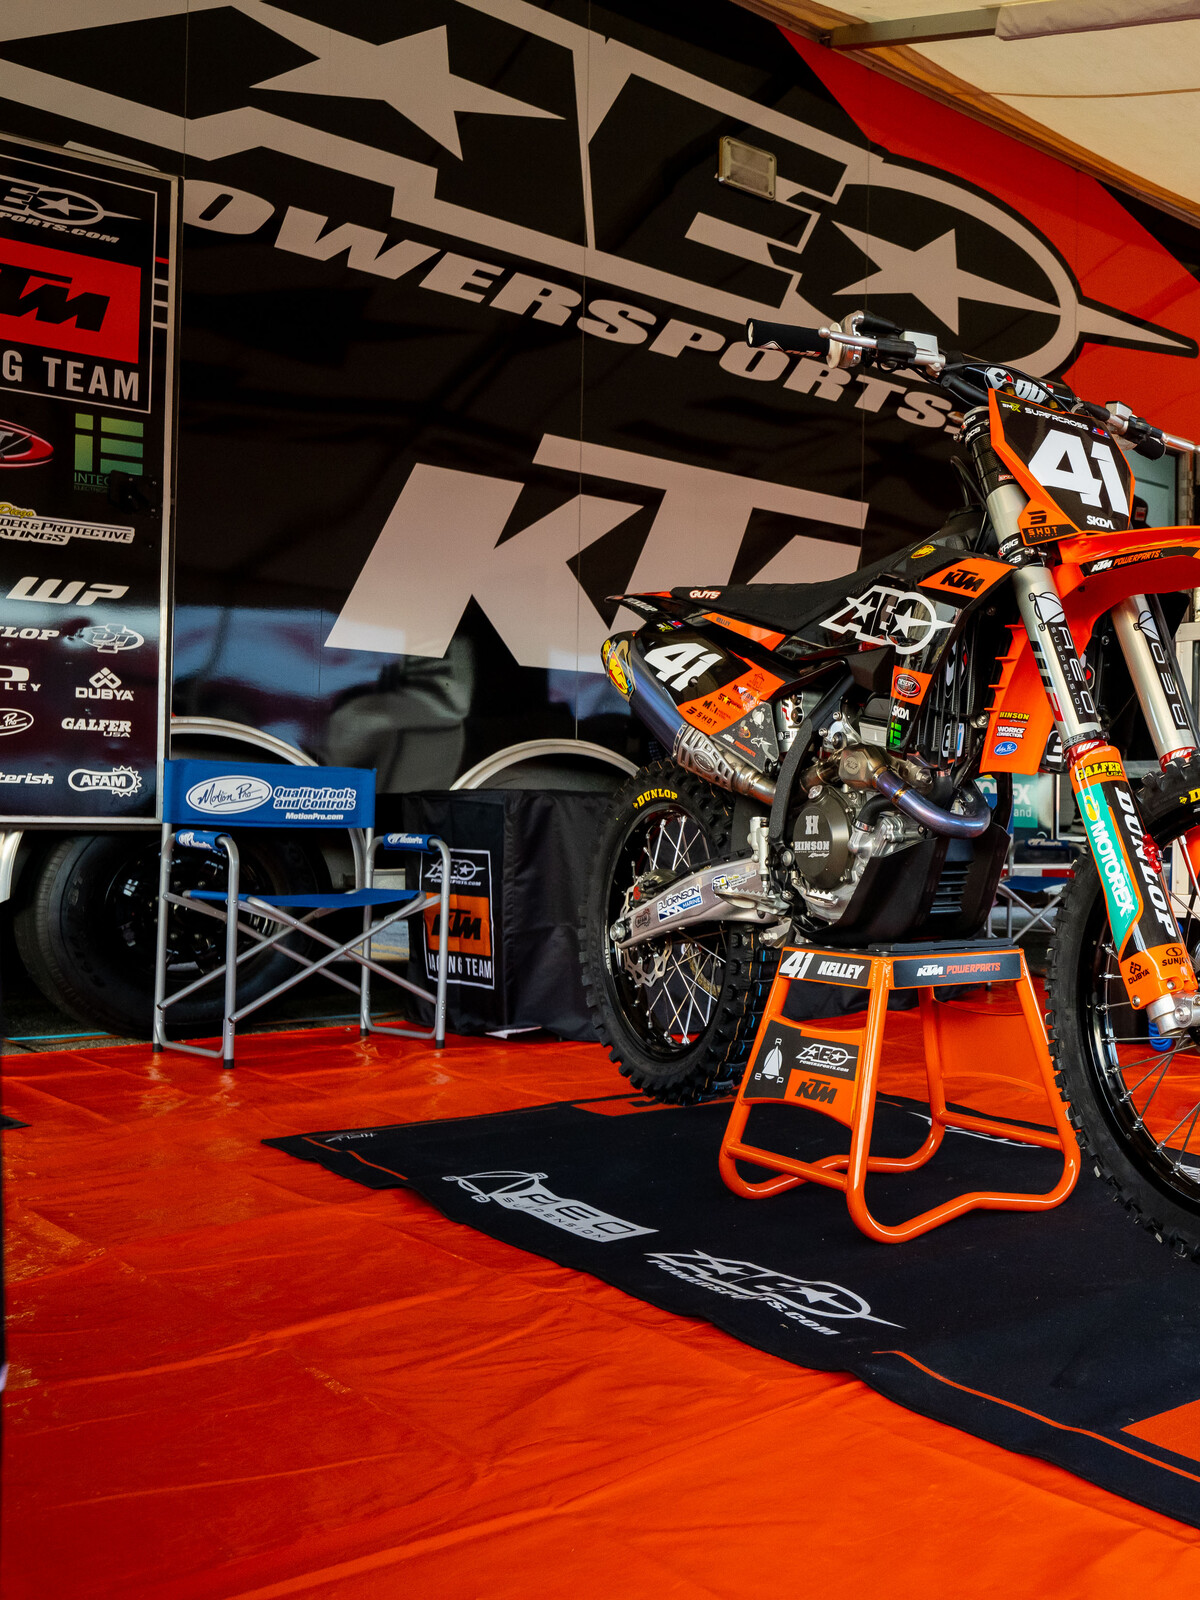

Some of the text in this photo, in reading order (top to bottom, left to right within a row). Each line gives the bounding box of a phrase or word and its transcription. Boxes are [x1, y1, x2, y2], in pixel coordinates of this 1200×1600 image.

[0, 262, 111, 333] TM
[42, 356, 139, 402] TEAM
[1024, 407, 1090, 430] SUPERCROSS
[1028, 428, 1131, 517] 41
[0, 518, 29, 530] DER
[41, 522, 132, 541] PROTECTIVE
[0, 529, 66, 542] ATINGS
[1028, 526, 1059, 536] SHOT
[1091, 549, 1161, 573] KTM POWERPARTS
[941, 569, 985, 593] KTM
[689, 590, 722, 600] GUTS
[0, 626, 60, 641] LOP
[643, 642, 724, 692] 41
[1050, 626, 1084, 715] SUSPENSION
[4, 682, 42, 692] LEY
[75, 687, 134, 701] DUBYA
[61, 717, 132, 732] GALFER
[696, 712, 718, 727] SHOT
[999, 711, 1030, 721] HINSON
[997, 726, 1026, 734] WORKS
[1077, 741, 1100, 753] WP
[1075, 761, 1122, 781] GALFER
[80, 774, 127, 787] AFAM
[197, 783, 236, 806] Motion
[273, 786, 357, 800] Quality Tools
[637, 788, 678, 808] DUNLOP
[273, 798, 357, 810] and Controls
[285, 812, 344, 820] MotionPro.com
[794, 841, 830, 851] HINSON
[1091, 820, 1135, 918] MOTOREX
[432, 909, 481, 941] KTM
[465, 957, 492, 979] TEAM
[779, 951, 865, 979] 41 KELLEY
[916, 962, 1001, 977] KTM POWERPARTS
[1127, 968, 1151, 985] DUBYA
[799, 1059, 850, 1073] POWERSPORTS.COM
[795, 1078, 838, 1105] KTM
[518, 1193, 637, 1235] AEO
